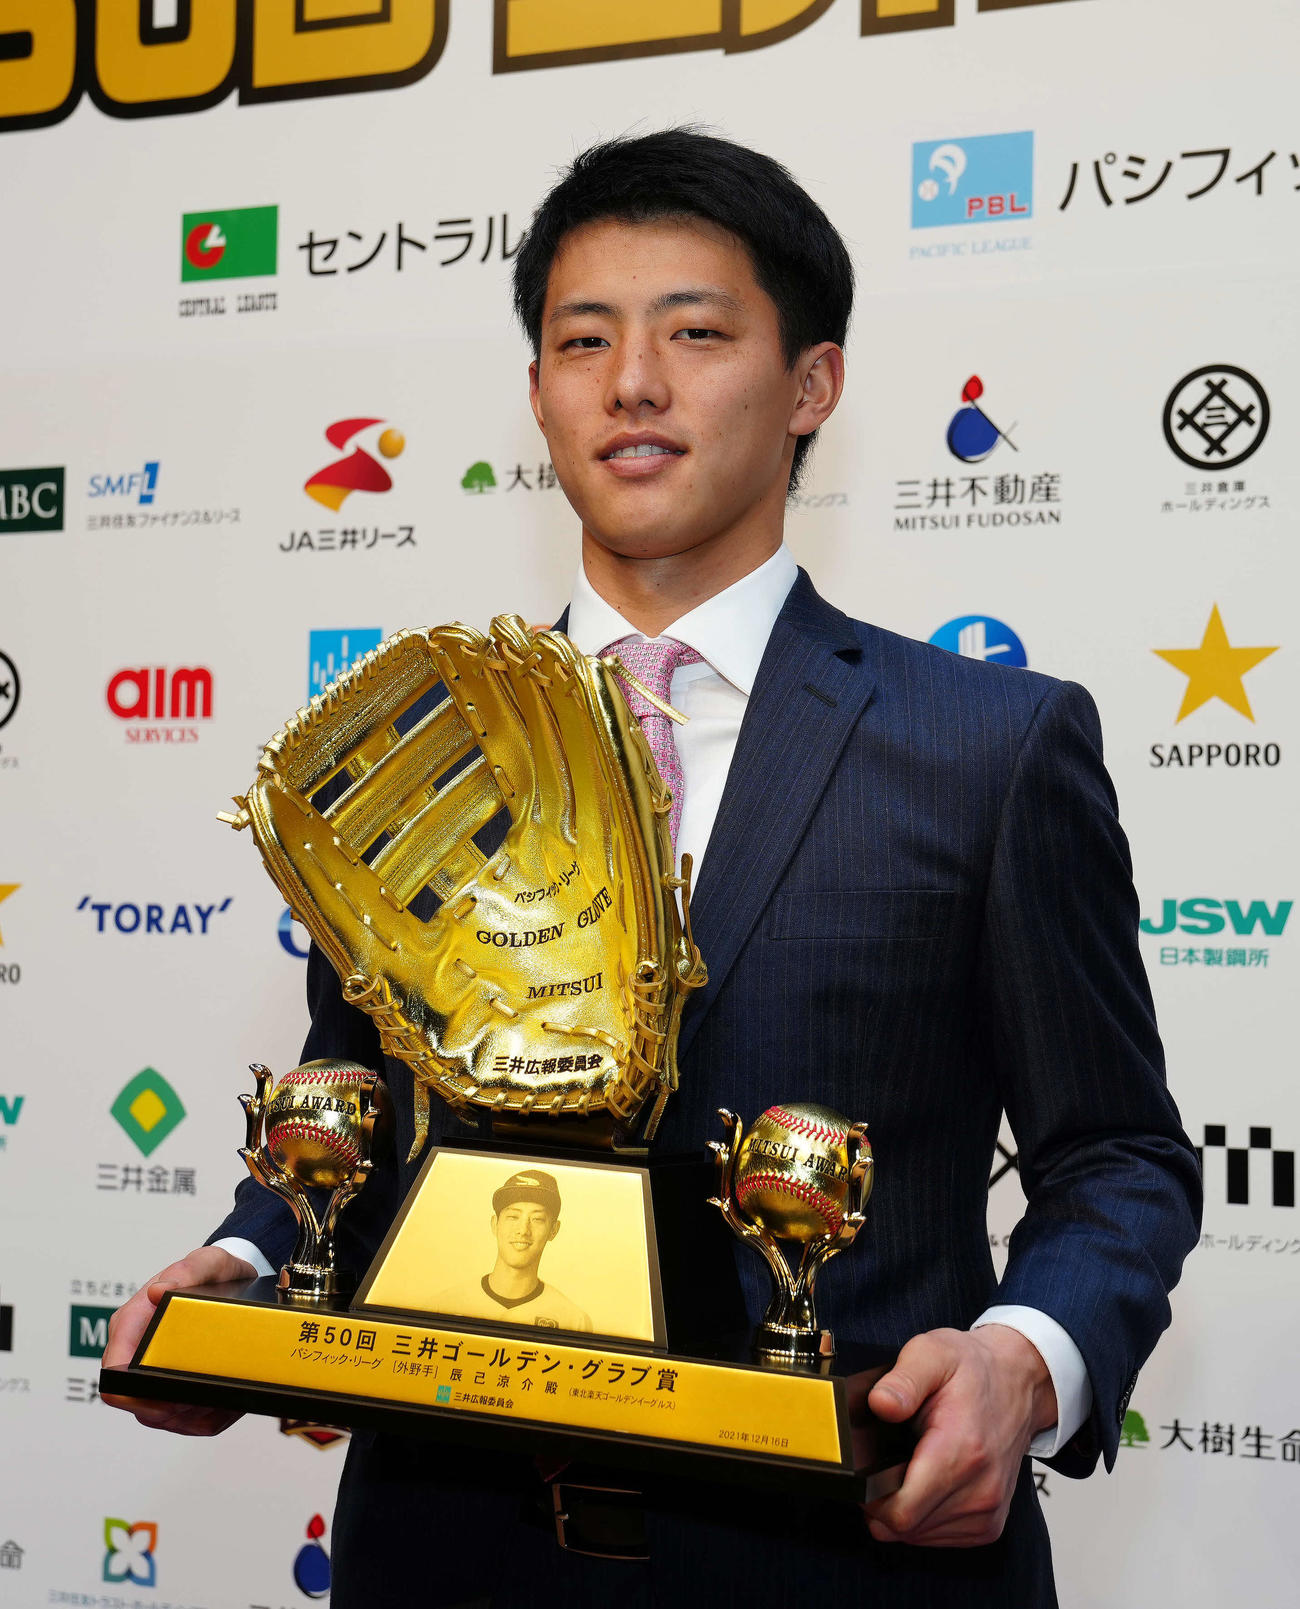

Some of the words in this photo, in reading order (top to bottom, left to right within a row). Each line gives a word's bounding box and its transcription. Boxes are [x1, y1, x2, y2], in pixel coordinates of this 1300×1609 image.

[967, 193, 1027, 218] PBL
[298, 213, 526, 276] セントラル
[894, 473, 1062, 510] 三井不動産
[893, 514, 961, 531] MITSUI
[966, 511, 1062, 528] FUDOSAN
[279, 526, 417, 553] JA三井リース
[125, 727, 199, 744] SERVICES
[1149, 743, 1282, 768] SAPPORO
[476, 922, 565, 949] GOLDEN
[577, 886, 613, 929] GLOVE
[1139, 898, 1293, 936] JSW
[1160, 946, 1269, 968] 日本製鋼所
[526, 973, 603, 1000] MITSUI
[492, 1055, 603, 1075] 三井広報委員会
[300, 1095, 357, 1116] AWARD
[748, 1138, 798, 1162] MITSUI
[803, 1153, 848, 1183] AWAR
[96, 1162, 197, 1196] 三井金属
[290, 1348, 385, 1371] パシフィック・リーグ
[298, 1320, 378, 1352] 第50回
[391, 1334, 680, 1394] 三井ゴールデン・グラブ賞
[453, 1391, 515, 1410] 三井広報委員会
[719, 1429, 790, 1449] 2021年12月16日
